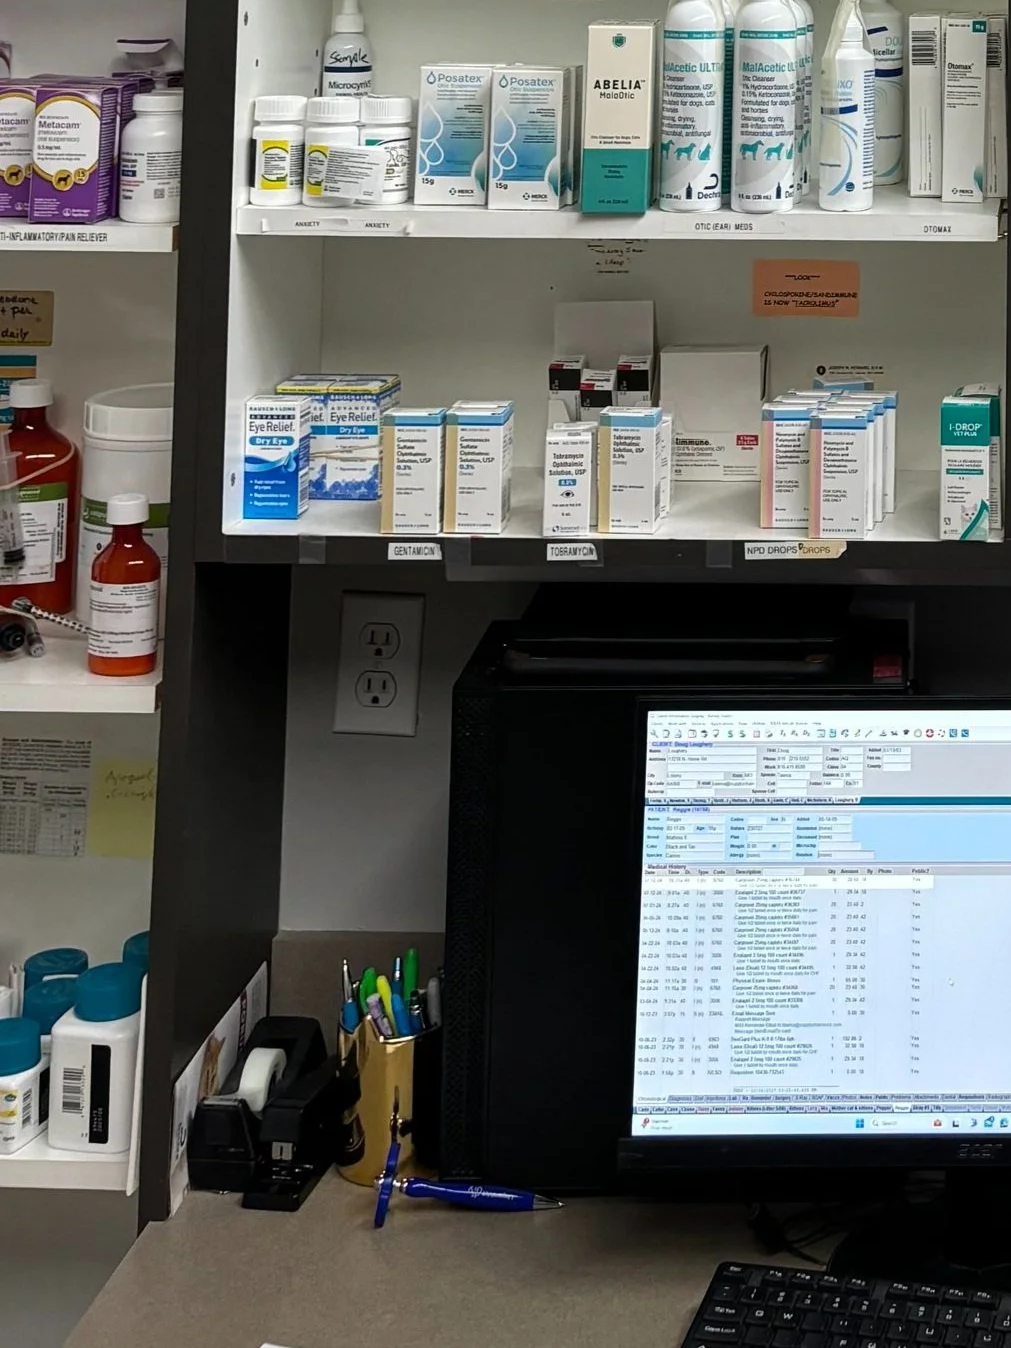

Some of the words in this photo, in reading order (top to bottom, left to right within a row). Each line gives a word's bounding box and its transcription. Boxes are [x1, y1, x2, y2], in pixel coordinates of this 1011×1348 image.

[742, 63, 786, 72] MalAcetic
[947, 62, 972, 71] Otomax
[438, 73, 482, 84] Posatex
[510, 76, 554, 87] Posatex
[594, 79, 642, 90] ABELIA
[599, 92, 635, 100] MalaOtic
[38, 121, 79, 129] Metacam
[295, 220, 320, 228] ANXIETY
[695, 222, 712, 231] OTIC
[712, 222, 732, 232] (EAR)
[735, 222, 753, 231] MEDS
[923, 225, 952, 233] OTOMAX
[77, 233, 107, 242] RELIEVER
[330, 412, 346, 423] Eye
[249, 422, 266, 433] Eye
[255, 438, 269, 446] Dry
[271, 438, 288, 446] Eye
[394, 546, 435, 556] GENTAMICIN
[747, 545, 765, 555] NPD
[768, 544, 797, 555] DROPS
